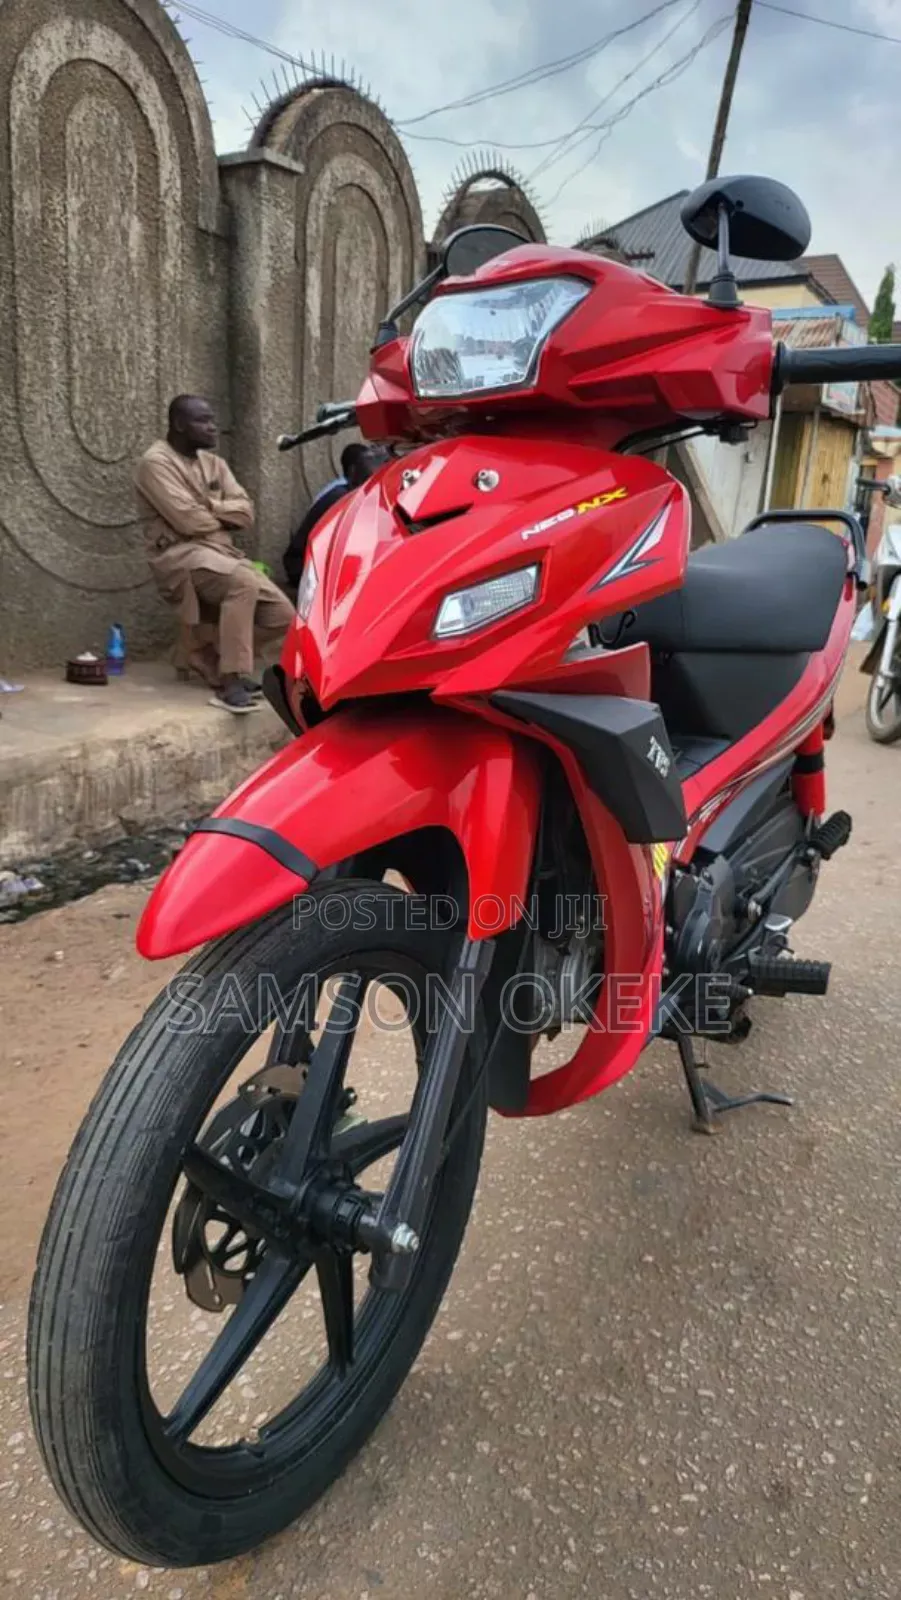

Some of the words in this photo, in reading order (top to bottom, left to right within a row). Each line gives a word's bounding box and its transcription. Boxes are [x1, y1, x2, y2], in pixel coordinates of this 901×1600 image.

[521, 508, 575, 540] NEO
[577, 487, 628, 515] NX
[646, 735, 670, 778] TVS
